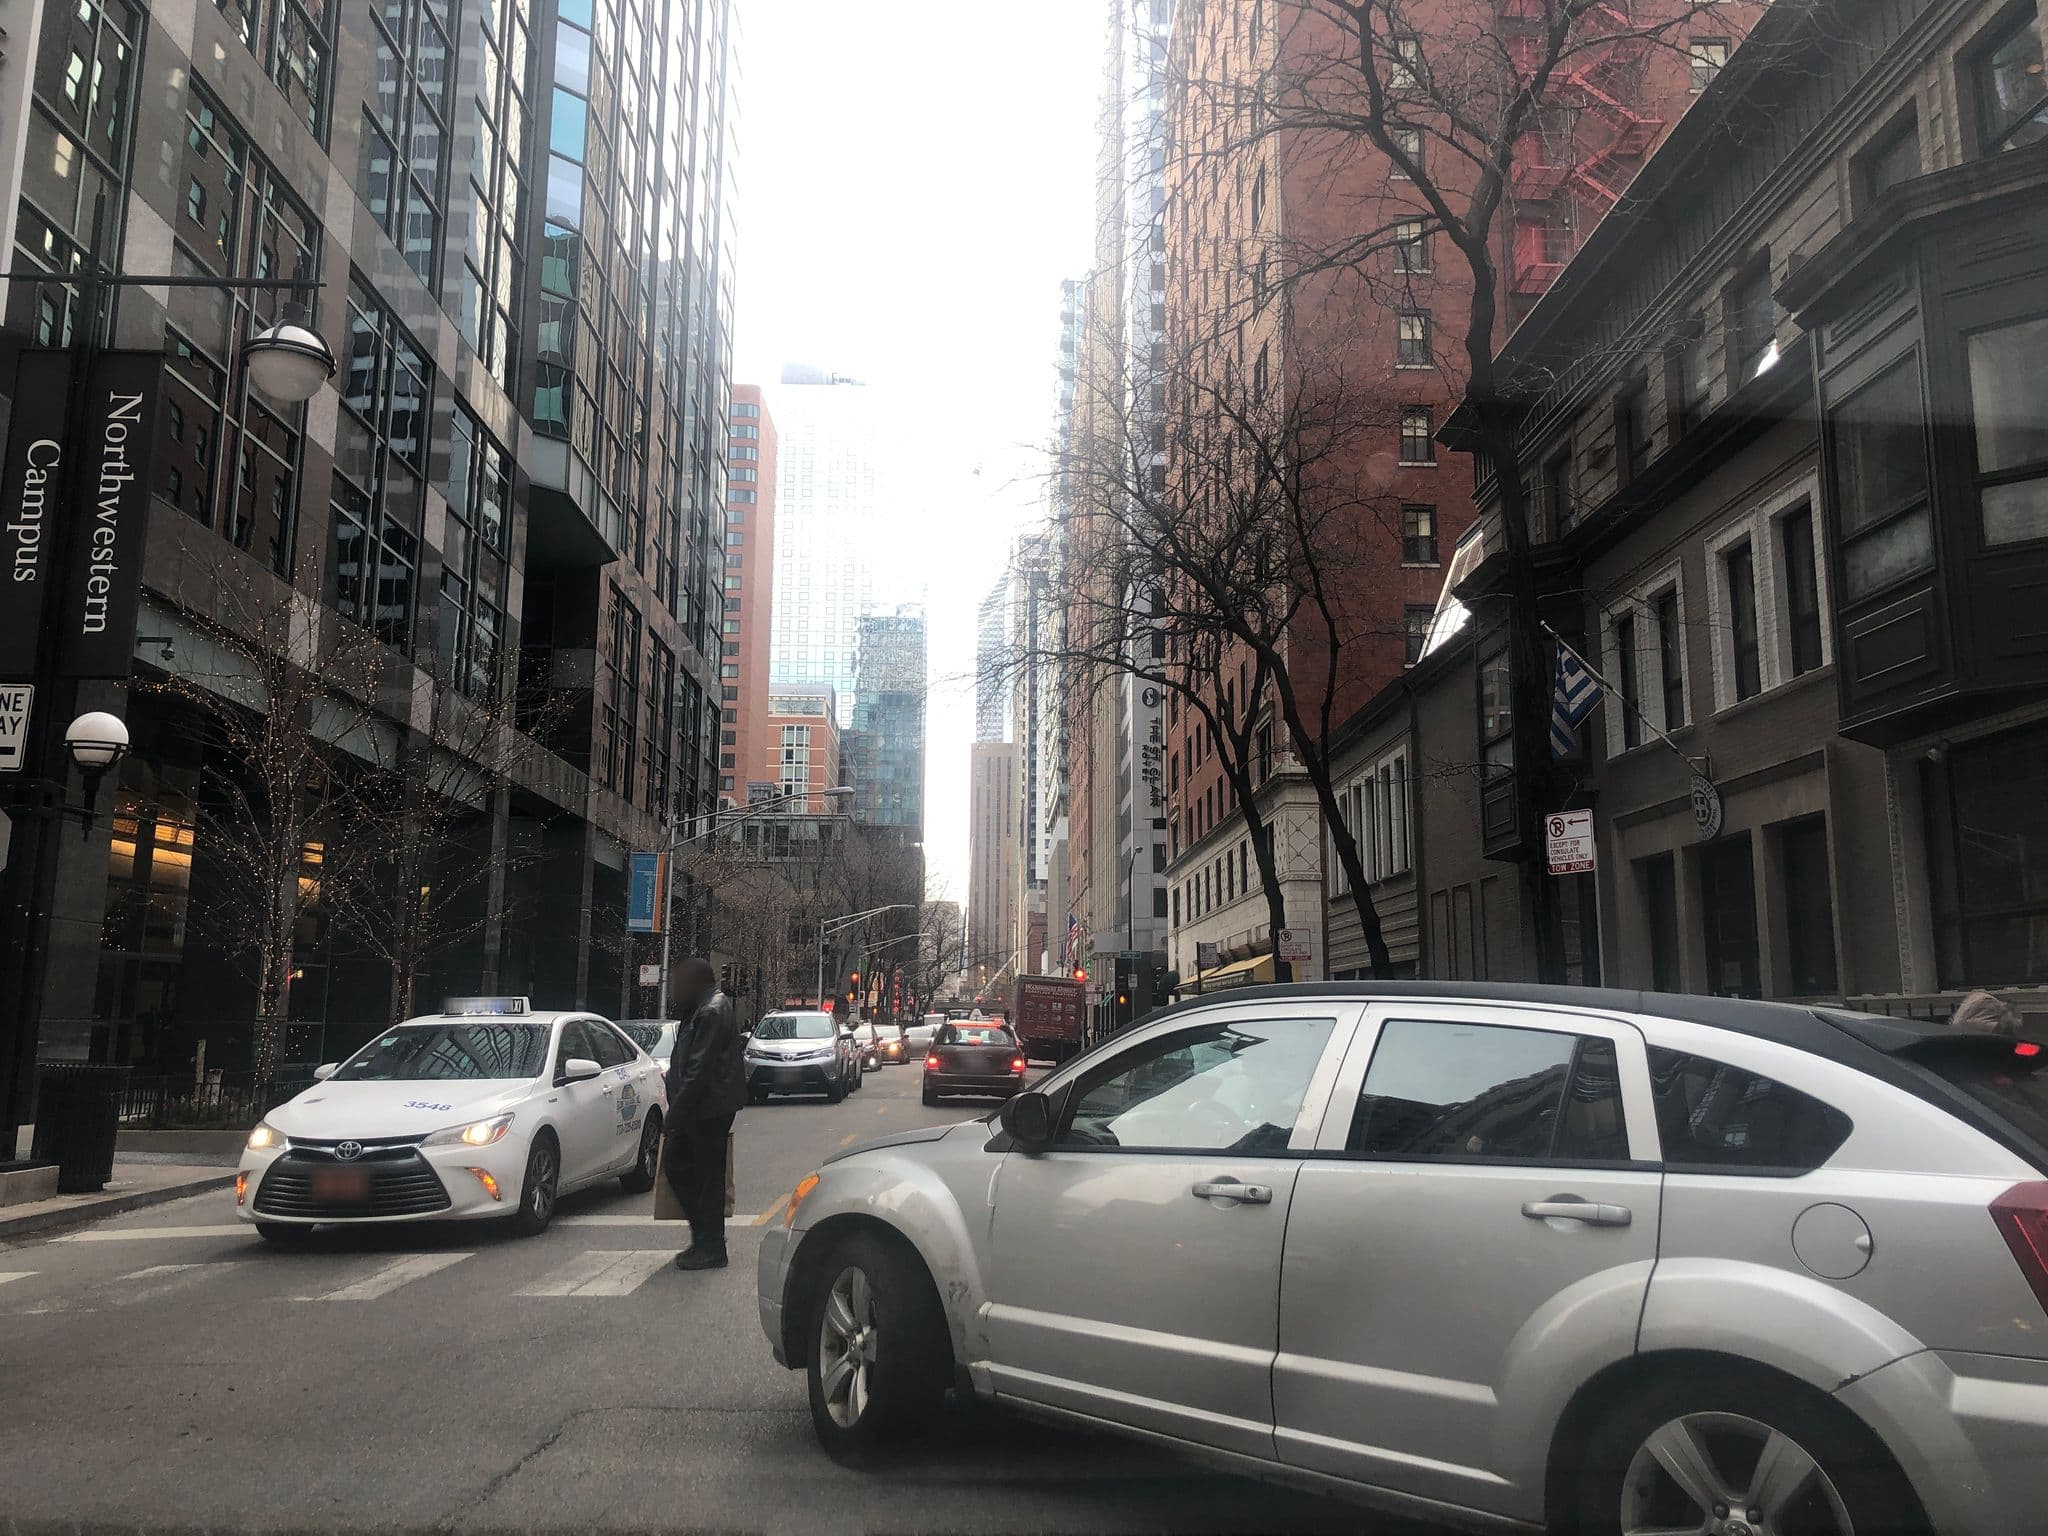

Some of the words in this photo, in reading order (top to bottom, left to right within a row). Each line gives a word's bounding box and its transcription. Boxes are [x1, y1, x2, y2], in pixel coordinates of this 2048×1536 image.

[6, 439, 61, 584] Campus
[82, 391, 144, 635] Northwestern
[0, 692, 25, 712] NE
[0, 716, 23, 735] AY
[1149, 717, 1160, 744] THE
[1149, 767, 1161, 808] CLAIR
[1550, 841, 1568, 849] EXCEPT
[1550, 847, 1580, 855] CONSULATE
[1551, 864, 1567, 872] TOW
[1570, 861, 1590, 870] ZONE
[403, 1101, 453, 1111] 3548
